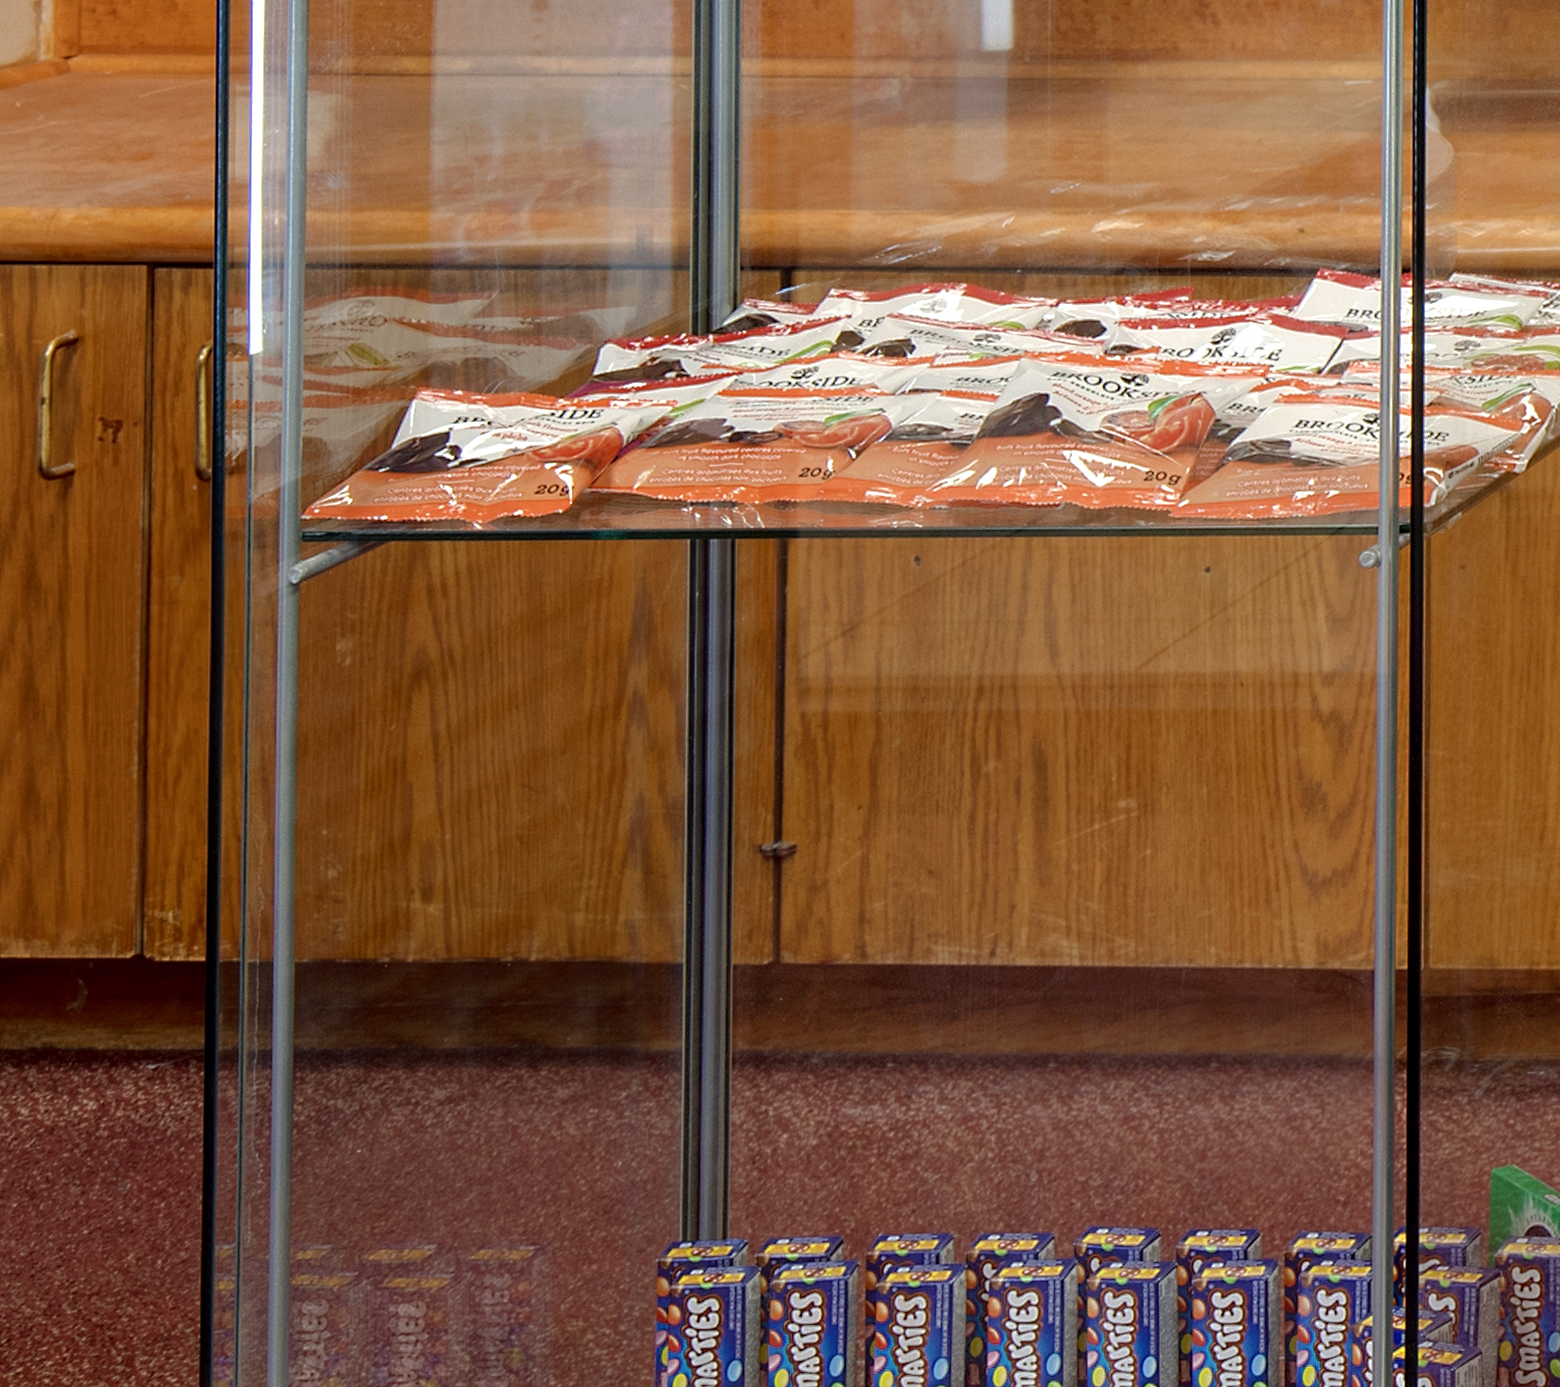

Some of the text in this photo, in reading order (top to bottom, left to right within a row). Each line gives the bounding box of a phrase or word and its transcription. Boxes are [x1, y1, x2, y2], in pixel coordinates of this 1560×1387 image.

[798, 466, 834, 480] 20g
[1143, 469, 1182, 486] 20g
[685, 1296, 720, 1387] MARTIES
[789, 1290, 825, 1387] MARTIES
[893, 1294, 928, 1387] MARTIES
[1006, 1290, 1040, 1387] MARTIES
[1101, 1290, 1135, 1387] MARTIES
[1210, 1289, 1243, 1387] MARTIES
[1316, 1289, 1348, 1387] MARTIES
[1514, 1266, 1543, 1387] SMARTIES
